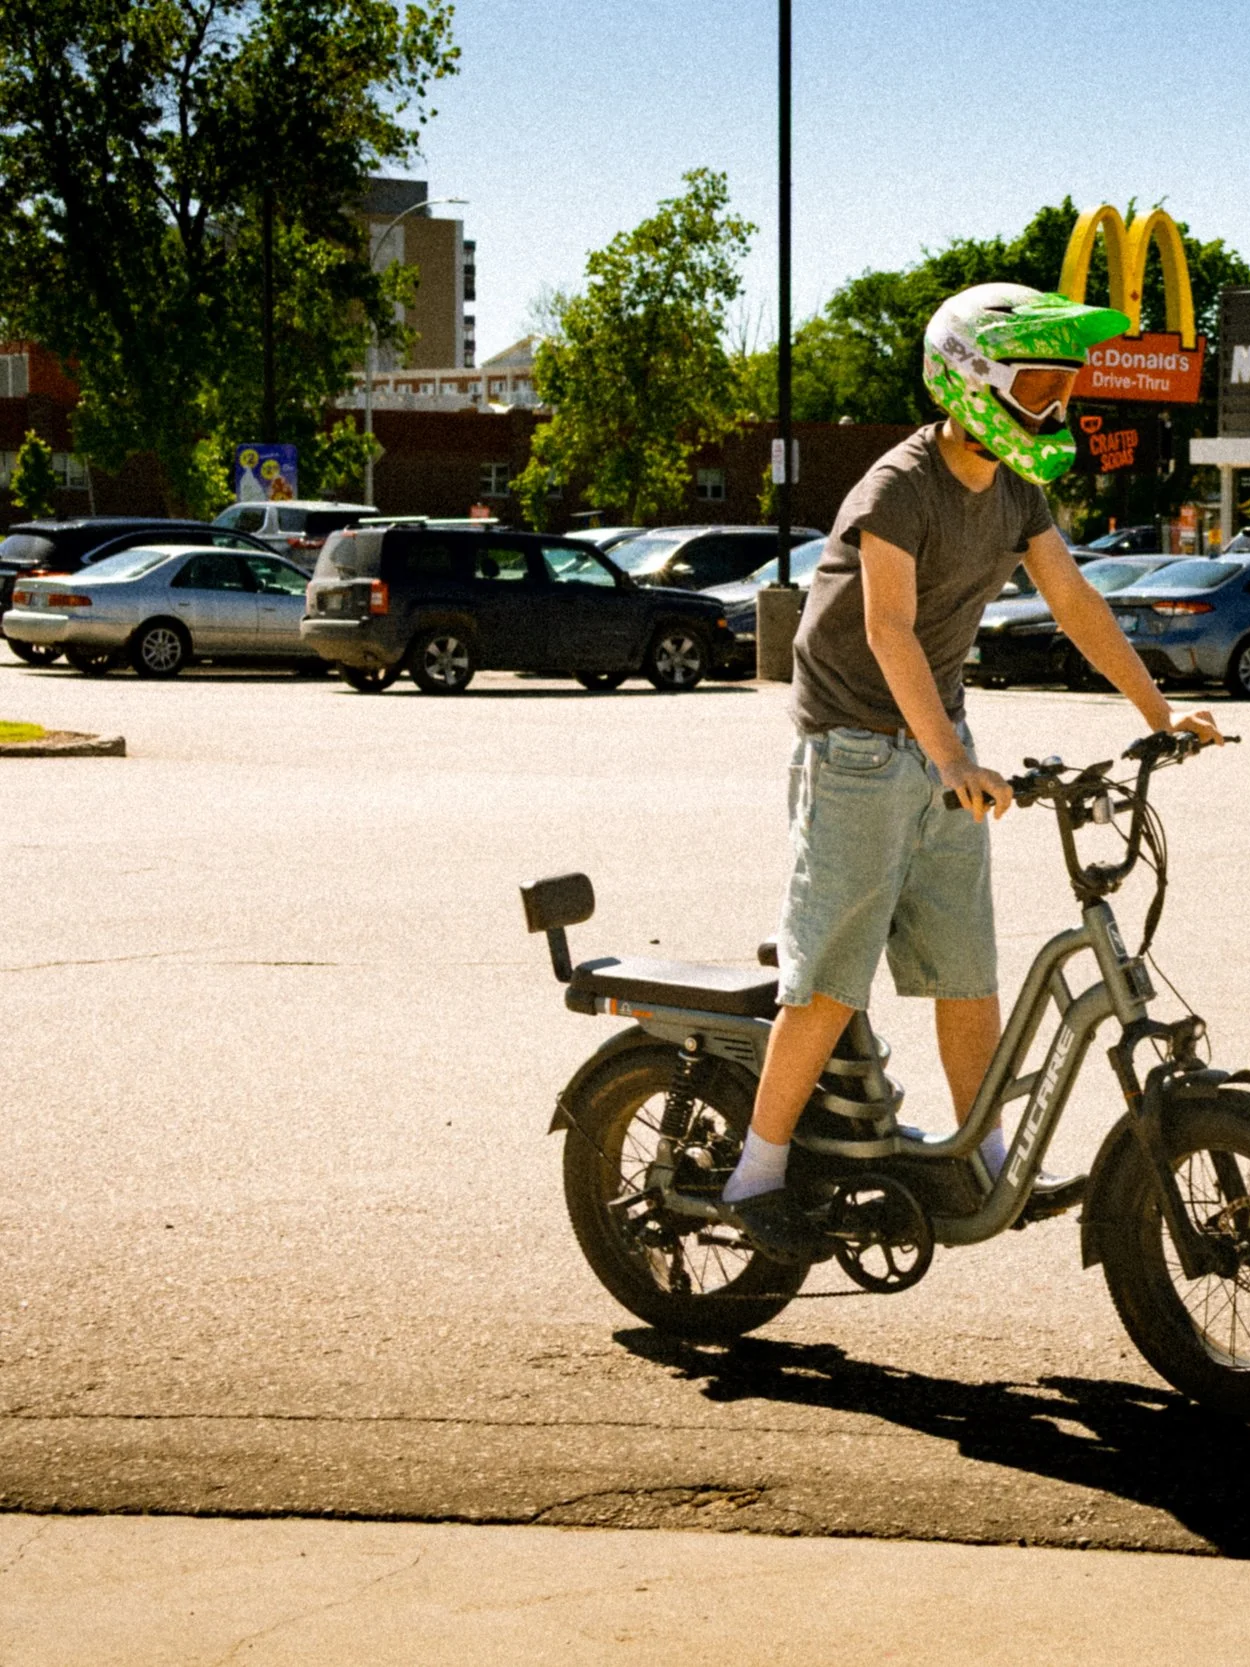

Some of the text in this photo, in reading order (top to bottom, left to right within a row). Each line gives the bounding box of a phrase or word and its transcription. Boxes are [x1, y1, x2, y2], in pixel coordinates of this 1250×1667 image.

[943, 336, 974, 362] SPY
[1092, 371, 1170, 391] Drive-Thru
[1089, 429, 1139, 456] CRAFTED
[1101, 447, 1135, 472] SODAS
[1006, 1023, 1076, 1188] FUCARE
